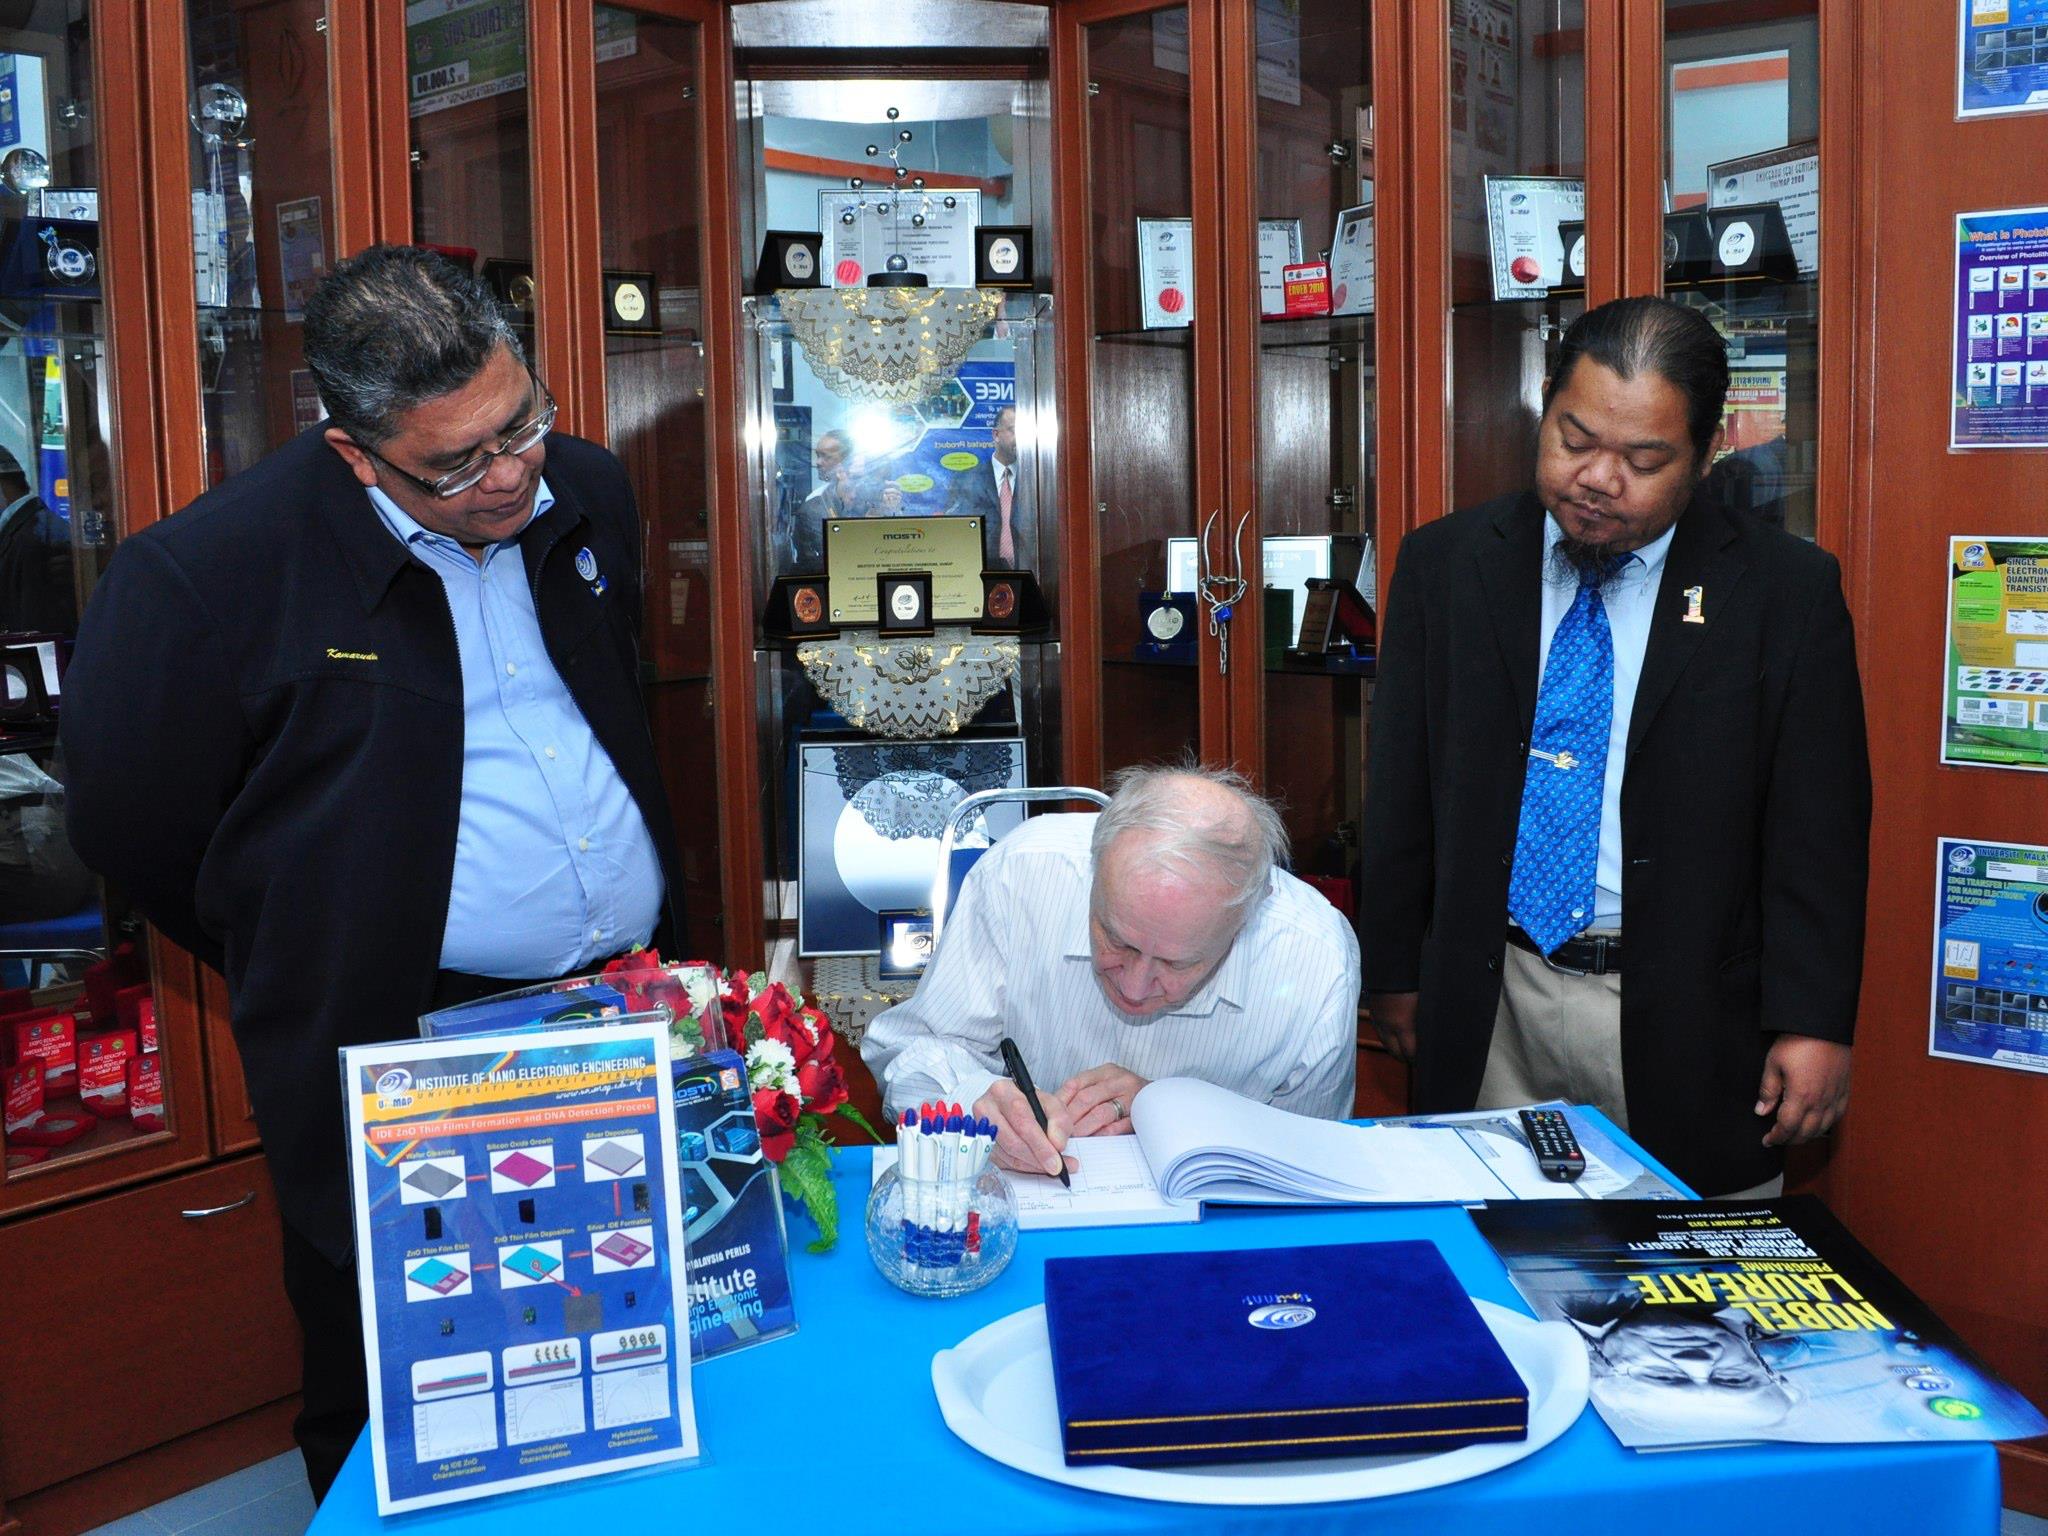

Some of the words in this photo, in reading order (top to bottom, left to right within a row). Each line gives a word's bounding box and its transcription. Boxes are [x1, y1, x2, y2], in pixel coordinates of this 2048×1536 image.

[1979, 253, 2010, 261] Overview
[2006, 557, 2036, 566] SINGLE
[2006, 575, 2047, 584] QUANTUM
[416, 1074, 469, 1091] INSTITUTE
[472, 1073, 486, 1085] OF
[489, 1069, 516, 1084] NANO
[519, 1063, 580, 1080] ELECTRONIC
[582, 1056, 646, 1074] ENGINEERING
[417, 1085, 506, 1100] UNIVERSITI
[516, 1076, 587, 1089] MALAYSIA
[377, 1128, 393, 1139] IDE
[397, 1127, 417, 1137] ZnO
[420, 1125, 441, 1134] Thin
[443, 1122, 469, 1133] Films
[471, 1114, 521, 1128] Formation
[524, 1112, 541, 1123] and
[544, 1109, 566, 1121] DNA
[568, 1105, 614, 1119] Detection
[616, 1102, 651, 1113] Process
[1684, 1211, 1726, 1219] Malaysia
[1727, 1209, 1772, 1219] Universiti
[620, 1218, 652, 1227] Formation
[1710, 1219, 1749, 1227] JANUARY
[524, 1231, 539, 1240] Film
[541, 1227, 575, 1237] Deposition
[1628, 1241, 1690, 1251] LEGGETT
[1693, 1239, 1738, 1249] JAMES
[1742, 1238, 1806, 1249] ANTHONY
[725, 1243, 751, 1260] PERLIS
[1705, 1248, 1733, 1257] SIR
[1732, 1247, 1818, 1257] PROFESSOR
[1737, 1262, 1833, 1273] PROGRAMME
[1628, 1273, 1864, 1305] LAUREATE
[1731, 1301, 1895, 1332] NOBEL
